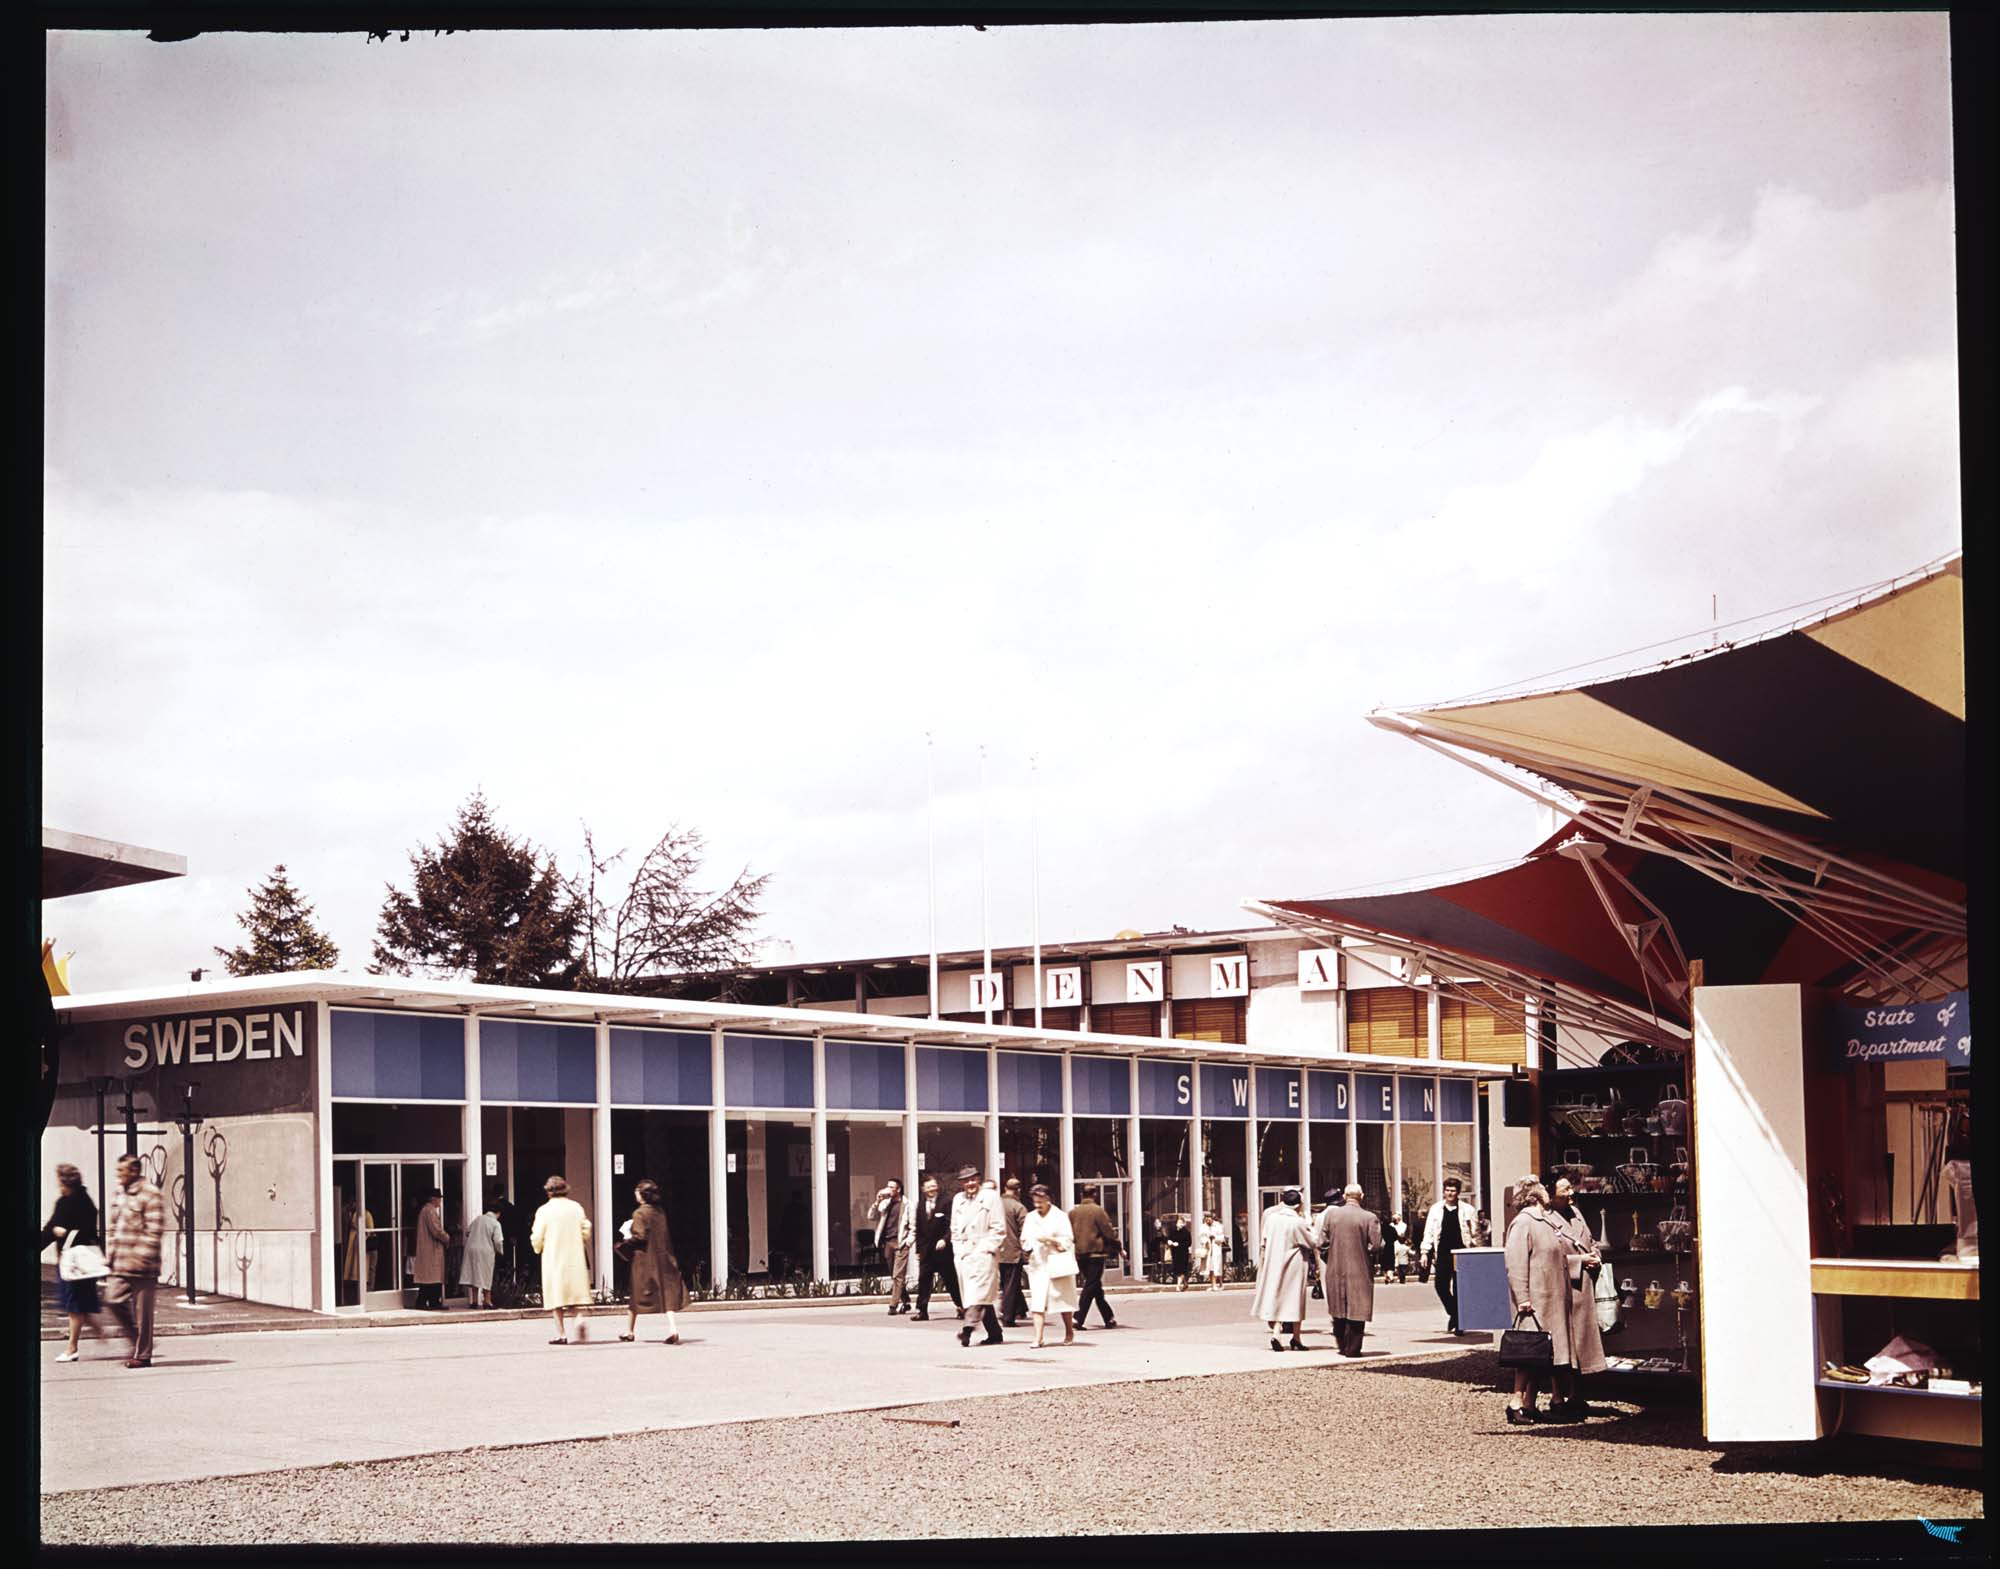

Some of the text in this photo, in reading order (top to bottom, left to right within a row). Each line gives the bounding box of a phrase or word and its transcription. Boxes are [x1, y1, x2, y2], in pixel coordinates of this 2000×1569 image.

[976, 955, 1407, 1004] DENMA
[1865, 1002, 1957, 1027] State of
[124, 1011, 303, 1068] SWEDEN
[1846, 1035, 1946, 1061] Department
[1177, 1075, 1433, 1112] SWEDEN
